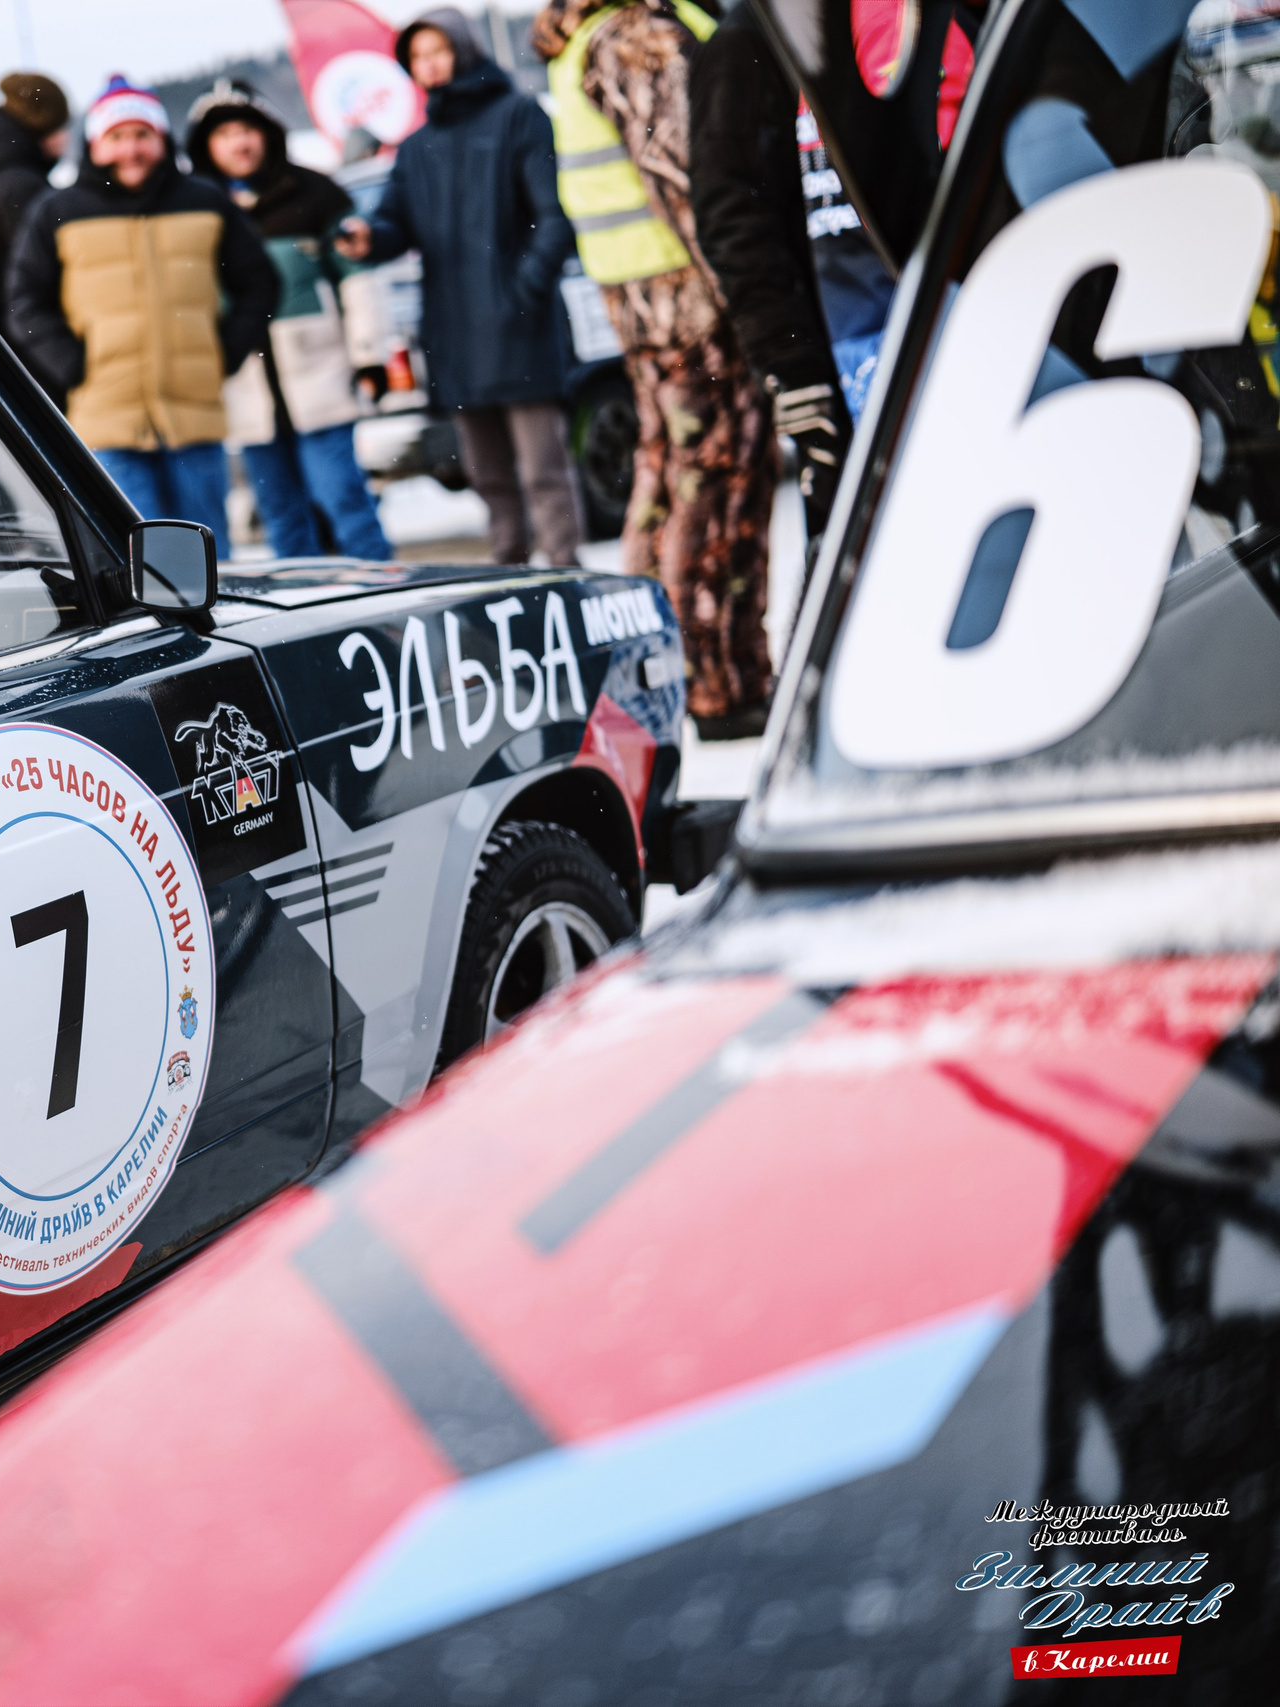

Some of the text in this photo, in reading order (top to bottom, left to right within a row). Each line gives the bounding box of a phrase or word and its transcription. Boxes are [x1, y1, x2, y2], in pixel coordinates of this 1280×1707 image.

[828, 156, 1273, 771] 6
[338, 591, 587, 772] ЭЛЬБА
[580, 586, 664, 646] MOTUL
[1, 757, 43, 792] «25
[48, 758, 126, 823] ЧАСОВ
[130, 811, 158, 862] НА
[156, 860, 195, 973] ЛЬДУ»
[233, 812, 274, 836] GERMANY
[10, 889, 89, 1120] 7
[40, 1202, 92, 1244] ДРАЙВ
[93, 1193, 106, 1216] В
[106, 1106, 168, 1205] КАРЕЛИИ
[53, 1212, 125, 1268] технических
[127, 1166, 158, 1214] видов
[157, 1104, 188, 1165] спорта
